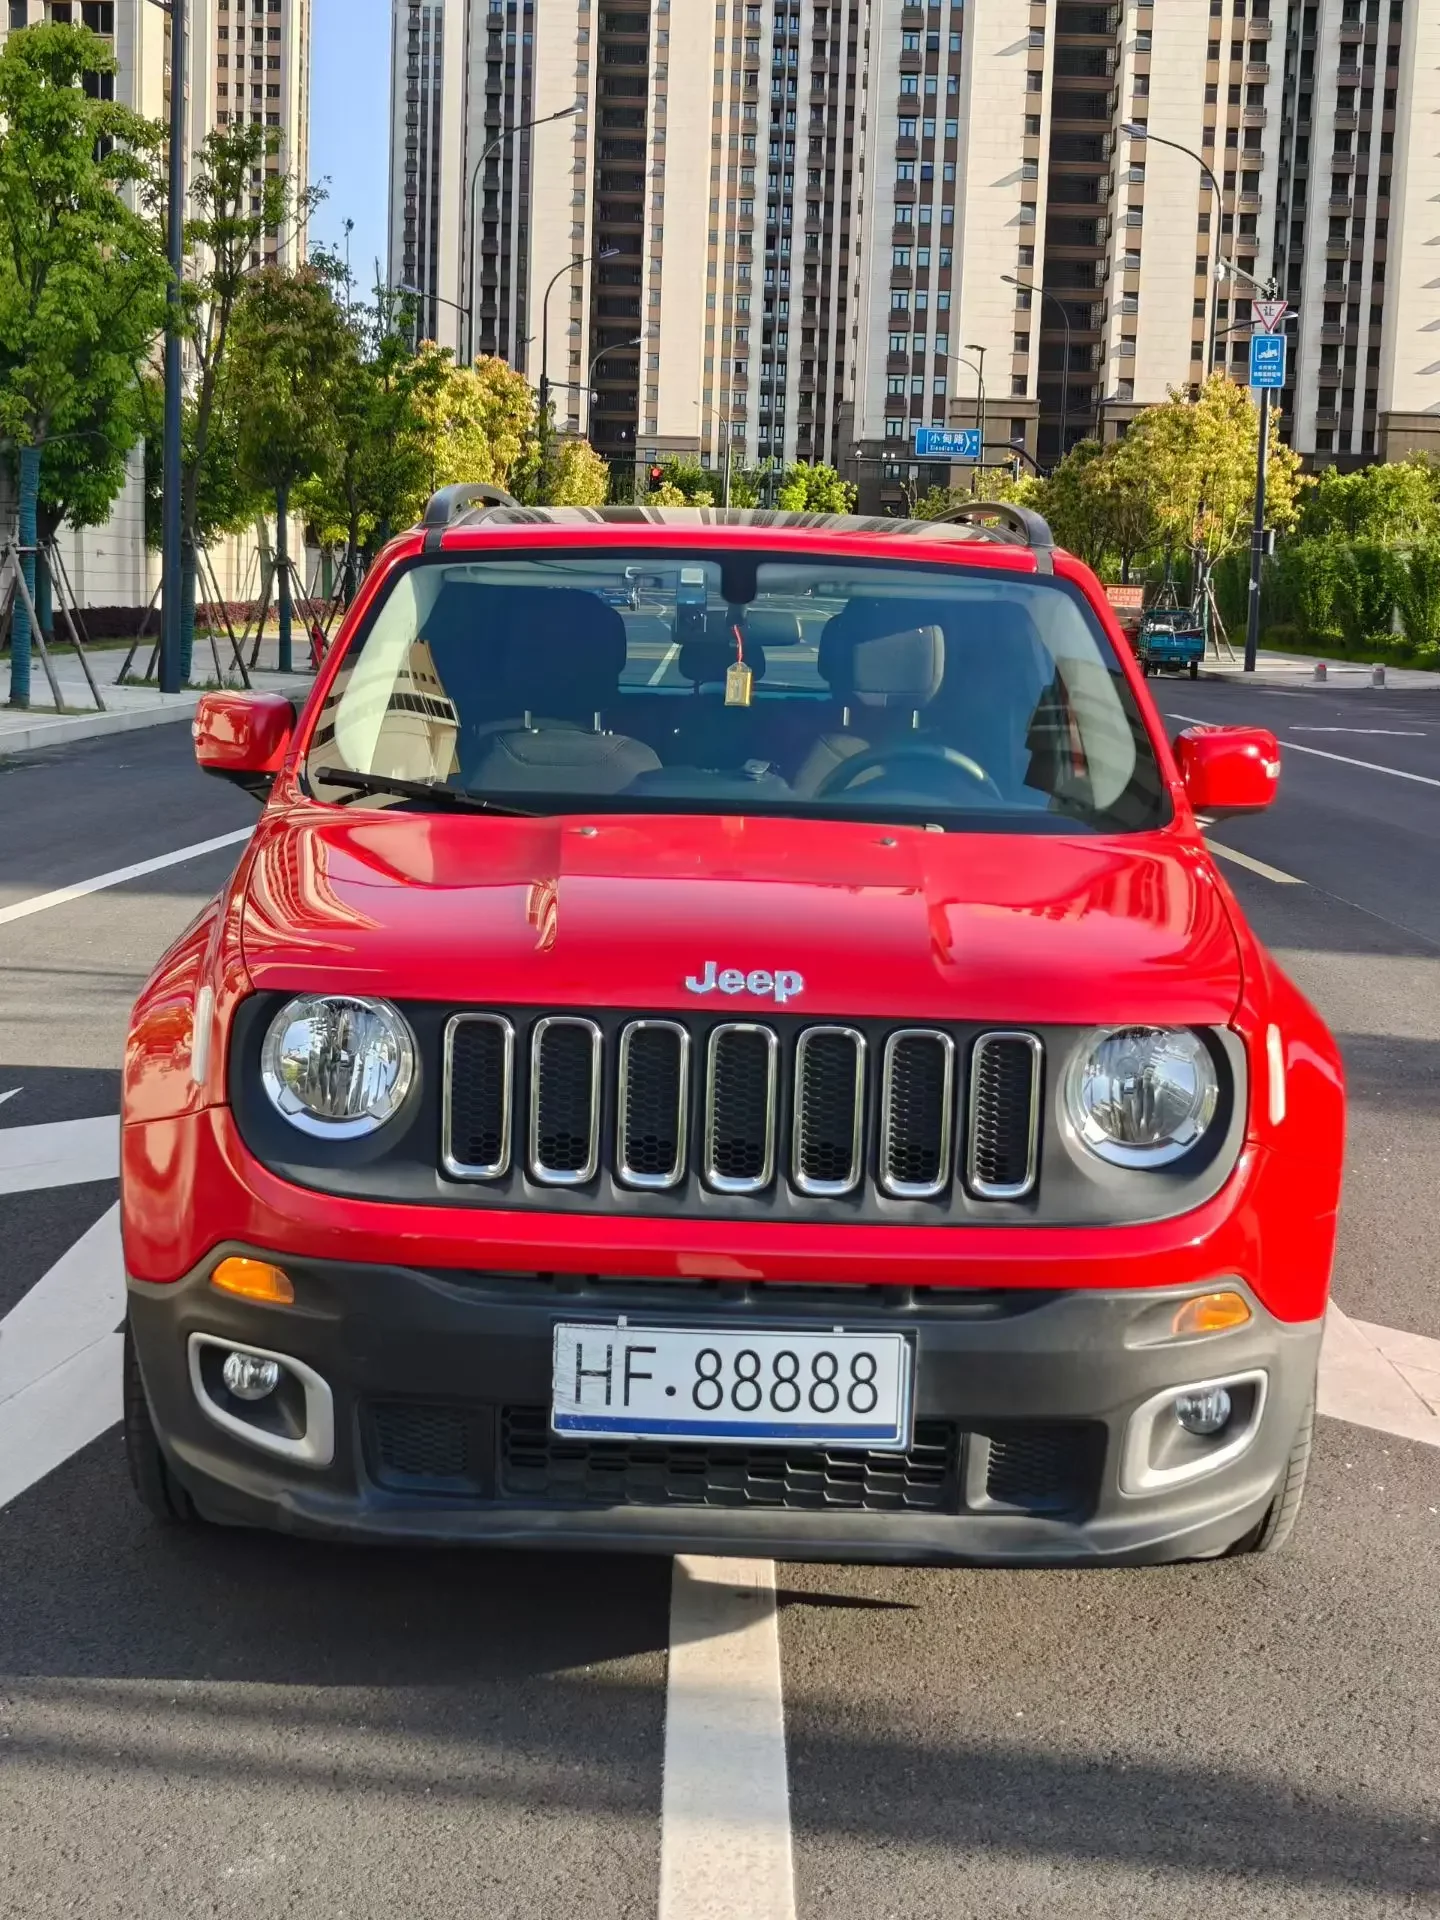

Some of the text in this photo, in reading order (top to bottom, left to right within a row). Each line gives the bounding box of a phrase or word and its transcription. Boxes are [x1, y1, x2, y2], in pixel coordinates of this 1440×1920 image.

[1264, 305, 1275, 316] 让
[930, 433, 964, 444] 小甸路
[685, 960, 804, 1003] Jeep
